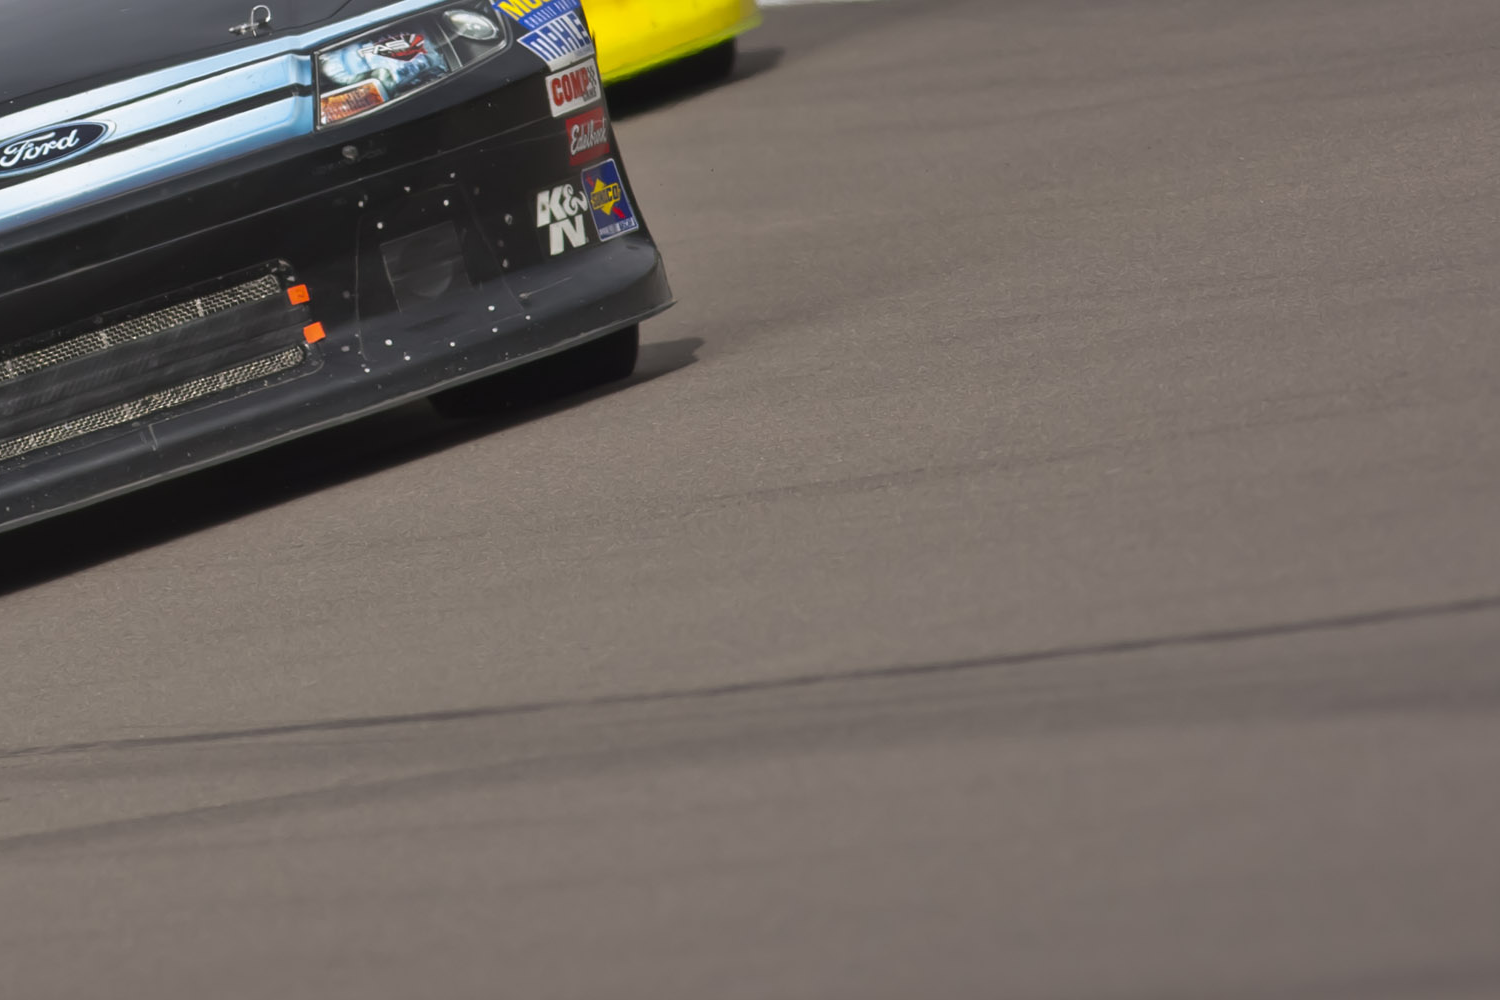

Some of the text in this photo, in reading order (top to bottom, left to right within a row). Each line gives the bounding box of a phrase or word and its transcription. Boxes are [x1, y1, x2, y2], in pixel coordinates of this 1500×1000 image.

[551, 67, 589, 106] COMP
[0, 128, 80, 168] Ford
[570, 119, 607, 155] Edelbrock
